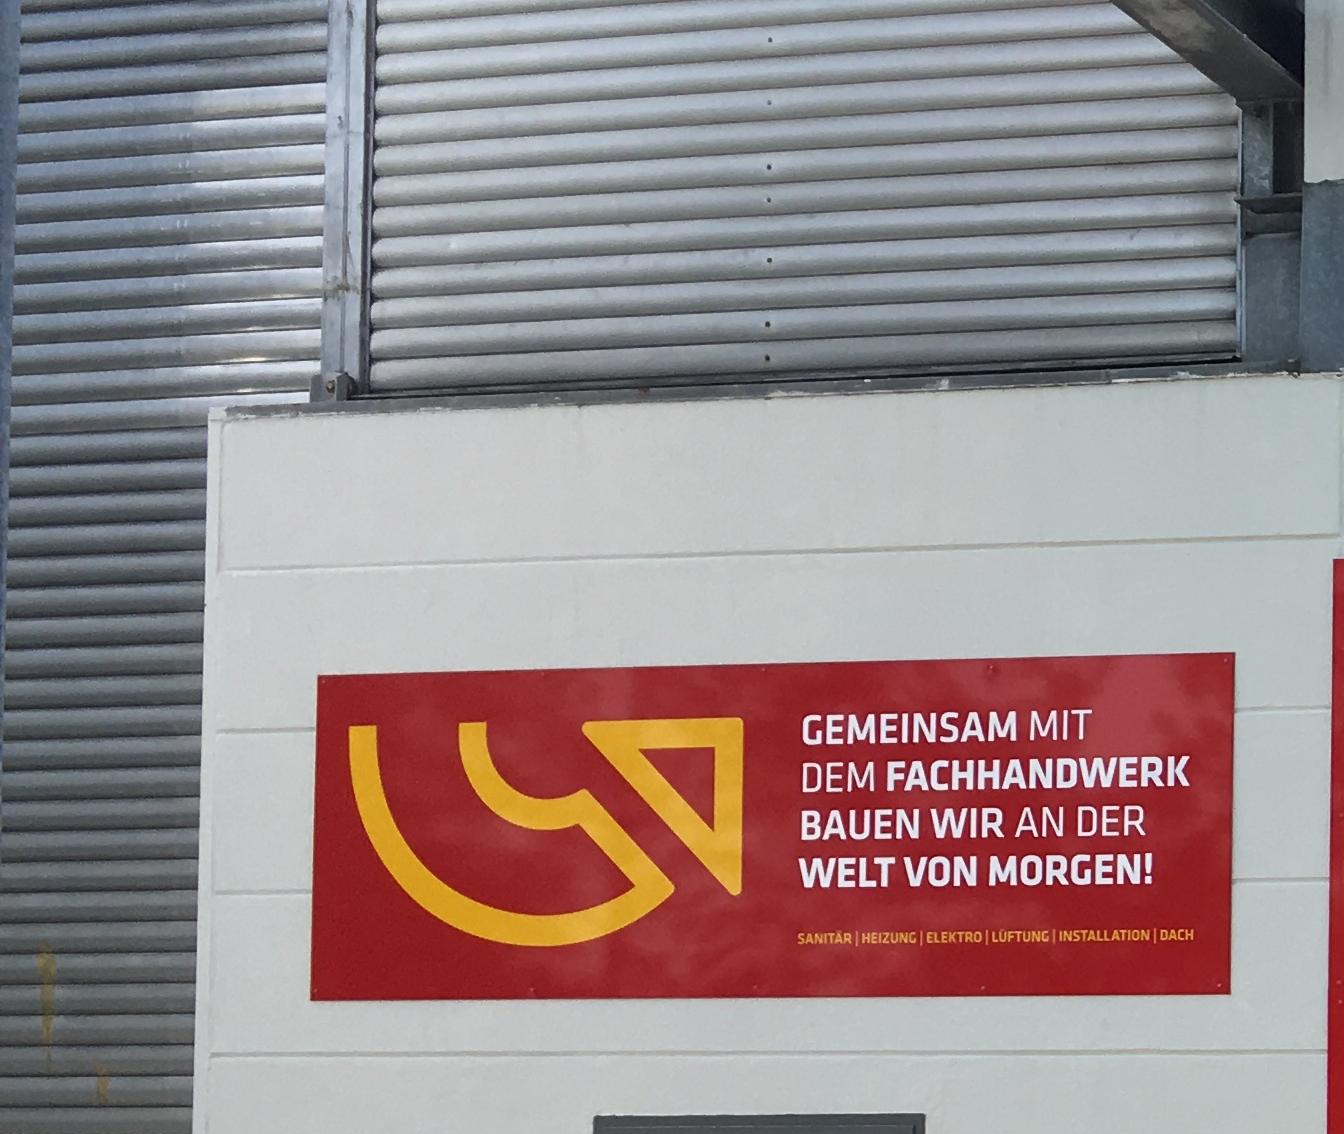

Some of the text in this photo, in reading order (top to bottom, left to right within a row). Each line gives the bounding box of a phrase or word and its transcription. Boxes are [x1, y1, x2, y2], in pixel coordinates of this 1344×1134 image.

[802, 709, 1092, 745] GEMEINSAM MIT
[802, 755, 1191, 793] DEM FACHHANDWERK
[800, 805, 1146, 841] BAUEN WIR AN DER
[799, 852, 1153, 888] WELT VON MORGEN!
[797, 927, 1194, 945] SANITÄR HEIZUNG ELEKTRO LÜFTUNG INSTALLATION DACH
